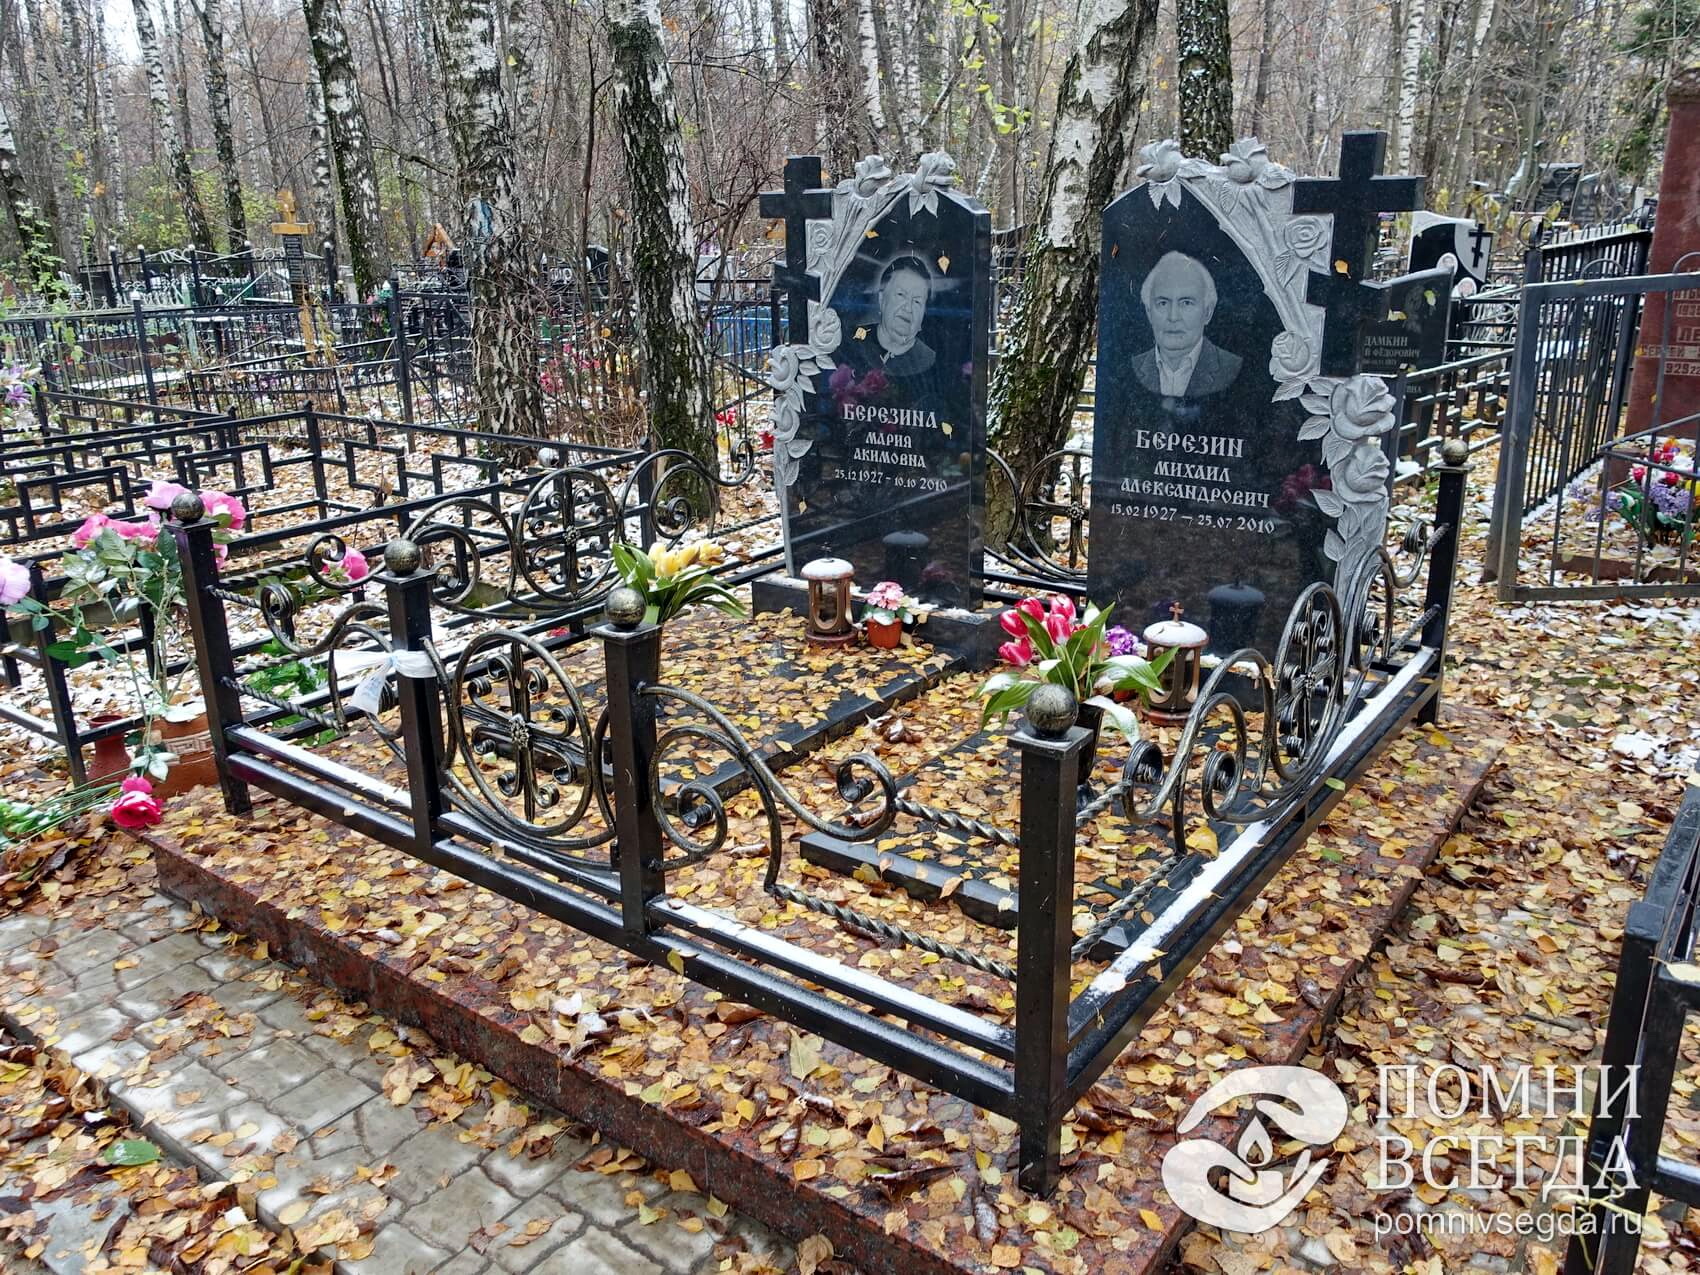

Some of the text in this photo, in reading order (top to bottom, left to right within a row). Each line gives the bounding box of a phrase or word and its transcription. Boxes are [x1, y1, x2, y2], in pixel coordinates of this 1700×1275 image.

[843, 403, 938, 429] БЕРЕЗИНА
[865, 431, 912, 449] МАРИЯ
[1135, 429, 1245, 458] БЕРЕЗИН
[853, 447, 927, 469] АКИМОВНА
[858, 470, 884, 484] 1927
[919, 477, 948, 492] 2010
[1153, 460, 1232, 483] МИХАИЛ
[1120, 477, 1271, 509] АЛЕКСАНДРОВИЧ
[1143, 505, 1177, 522] 1927
[1197, 514, 1233, 529] 25.07
[1236, 516, 1276, 534] 2010
